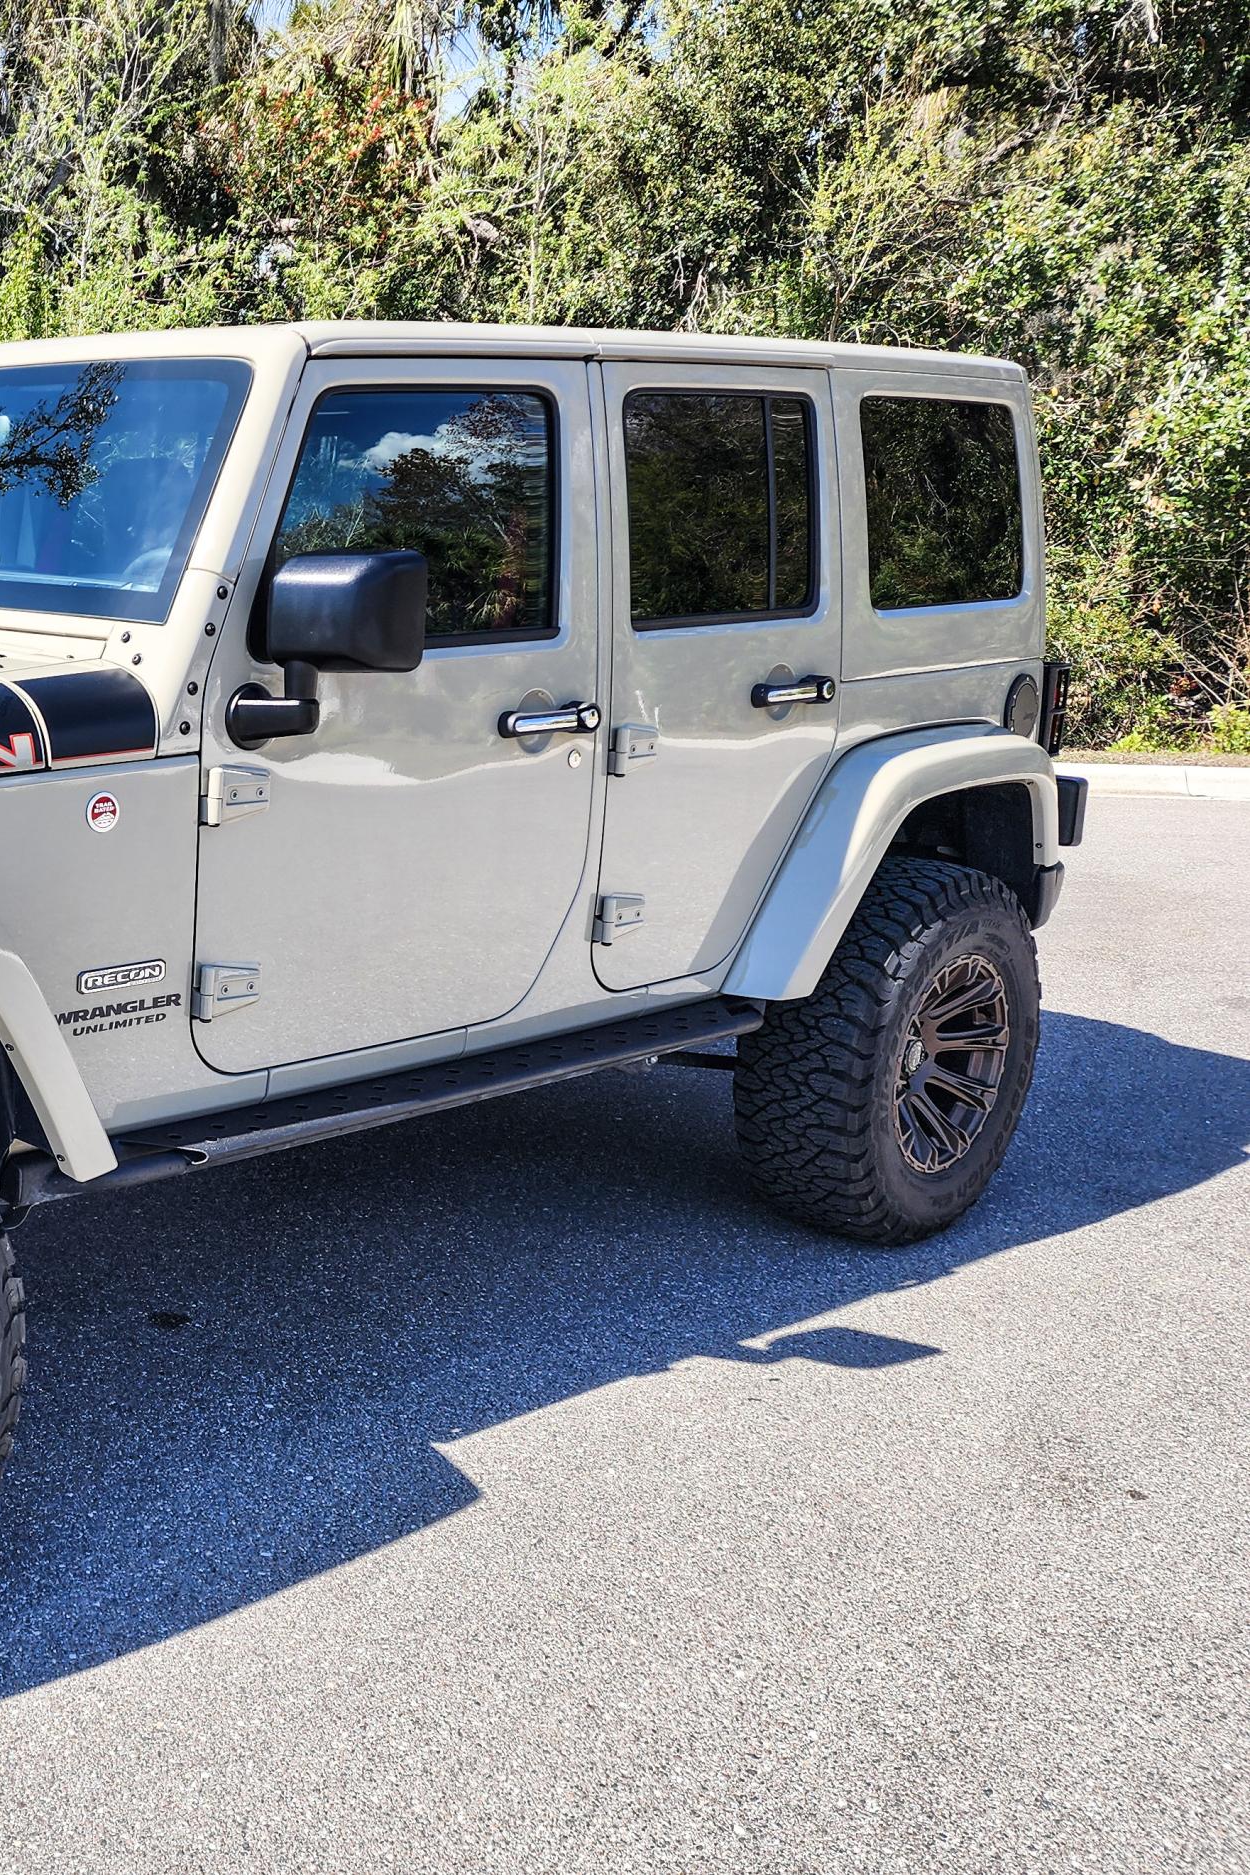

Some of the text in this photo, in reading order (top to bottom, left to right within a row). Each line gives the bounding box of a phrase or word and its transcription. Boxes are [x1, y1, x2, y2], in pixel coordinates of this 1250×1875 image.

[86, 965, 160, 988] RECON
[55, 993, 182, 1025] WRANGLER
[73, 1013, 167, 1036] UNLIMITED
